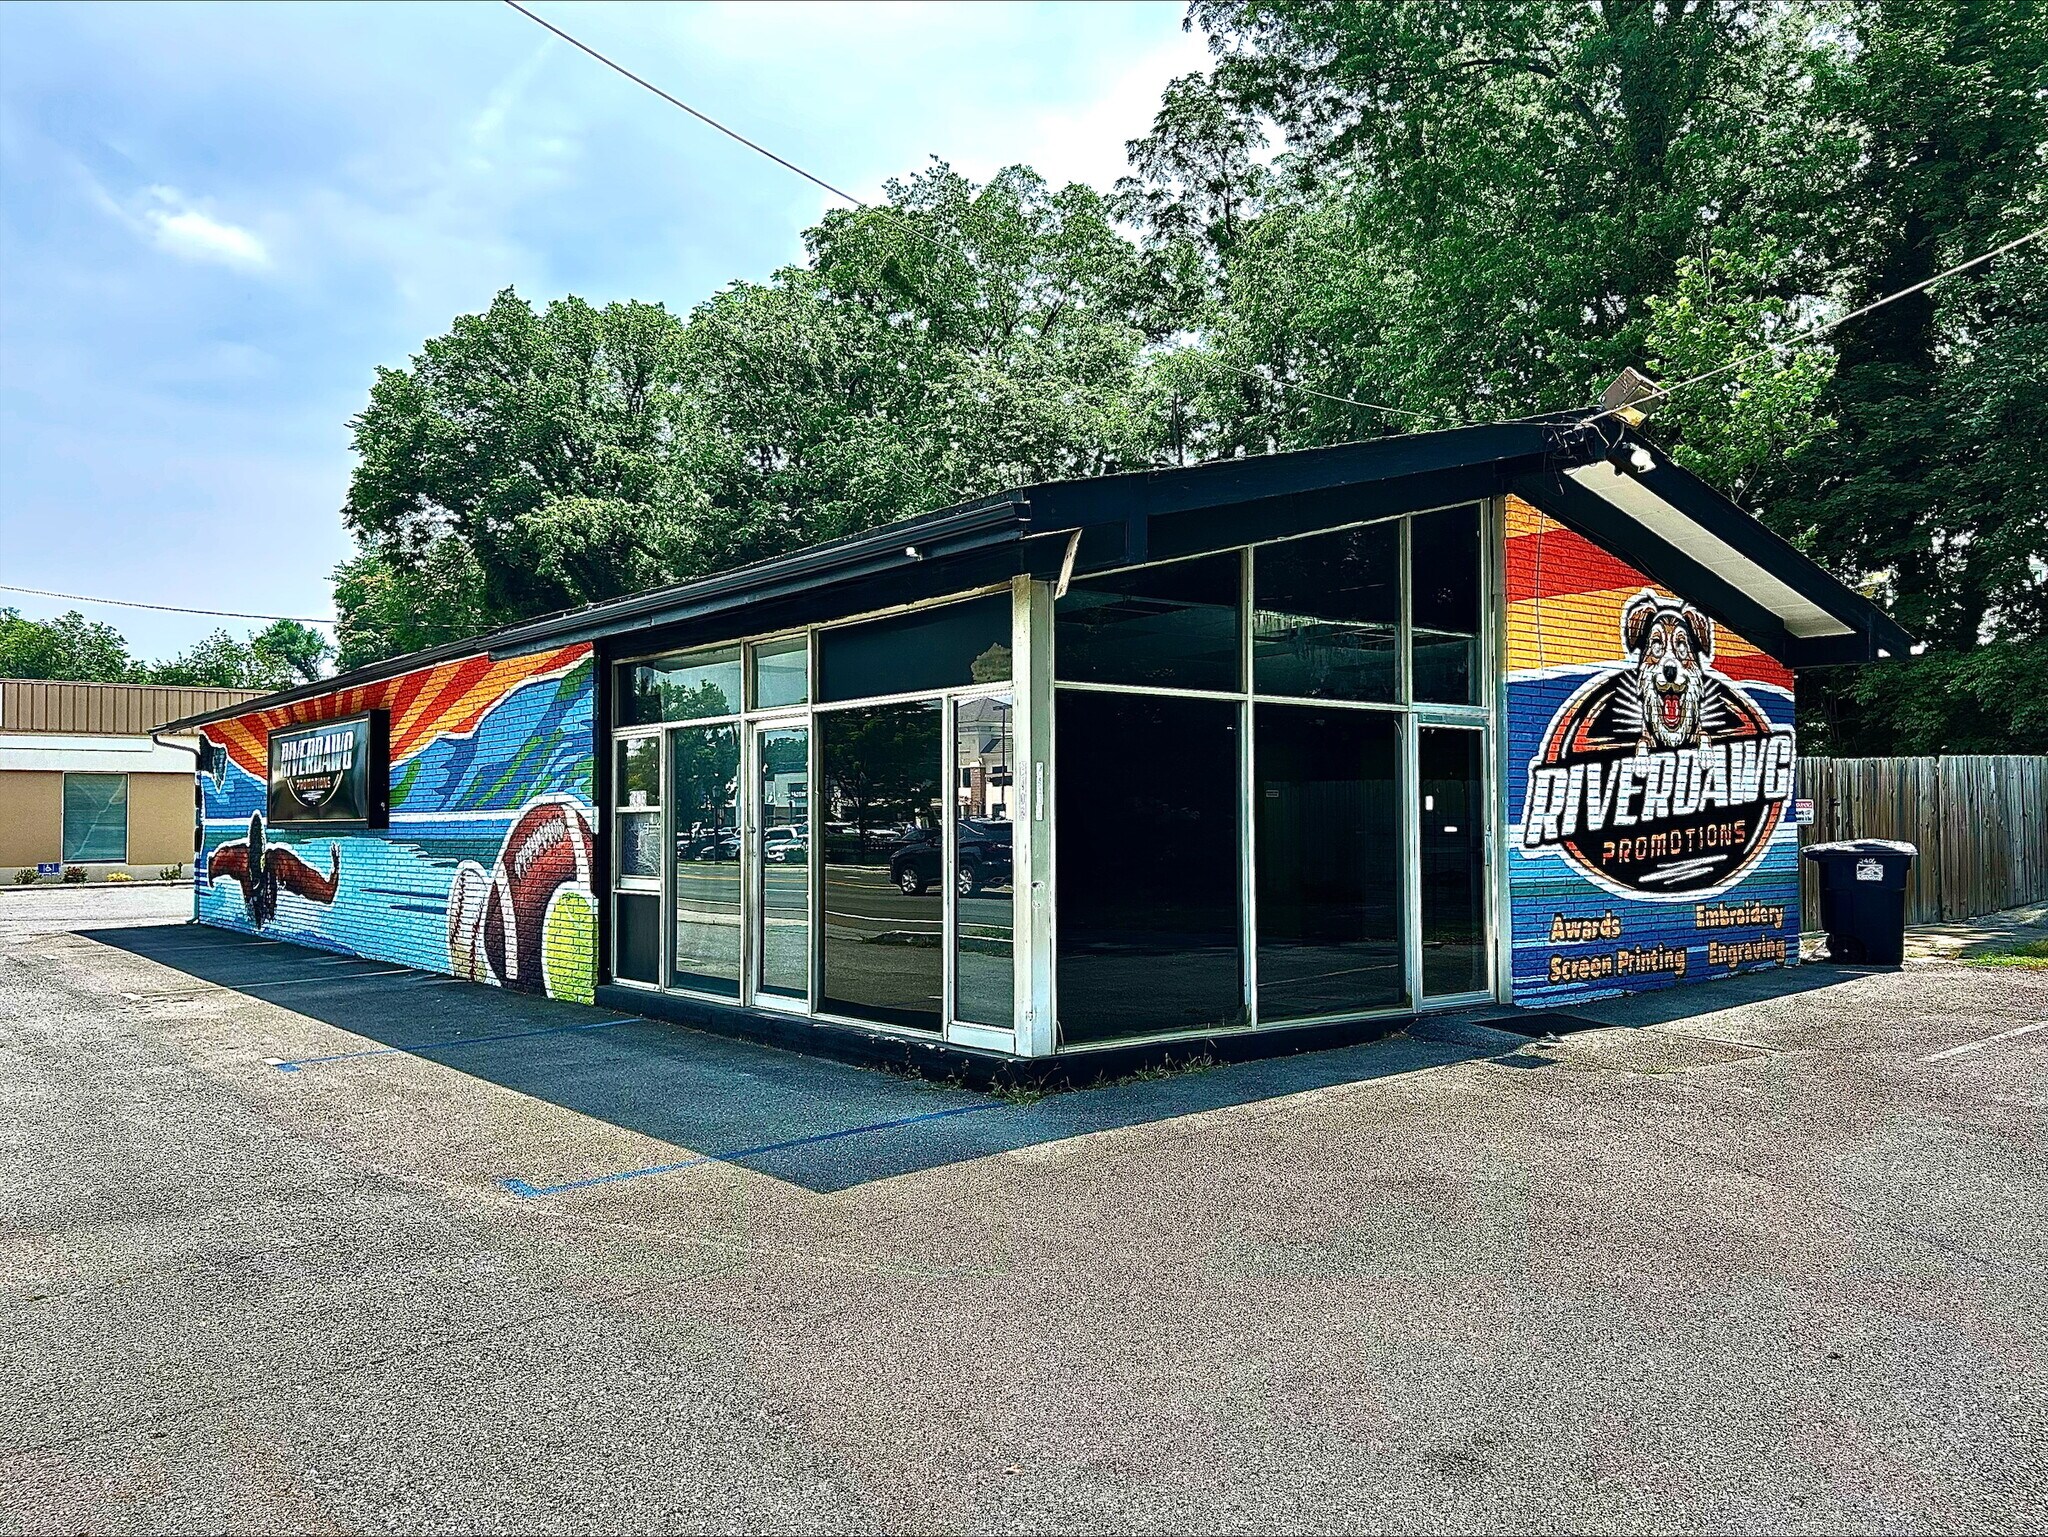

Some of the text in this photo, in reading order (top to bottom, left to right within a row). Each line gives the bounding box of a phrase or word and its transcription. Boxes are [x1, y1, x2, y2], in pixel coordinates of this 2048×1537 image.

[1524, 732, 1792, 847] RIVERDAWG
[1602, 819, 1747, 866] PROMOTIONS
[1550, 912, 1621, 940] Awards
[1696, 903, 1784, 929] Embroidery
[1550, 944, 1688, 981] Screen Printing
[1708, 934, 1786, 970] Engraving
